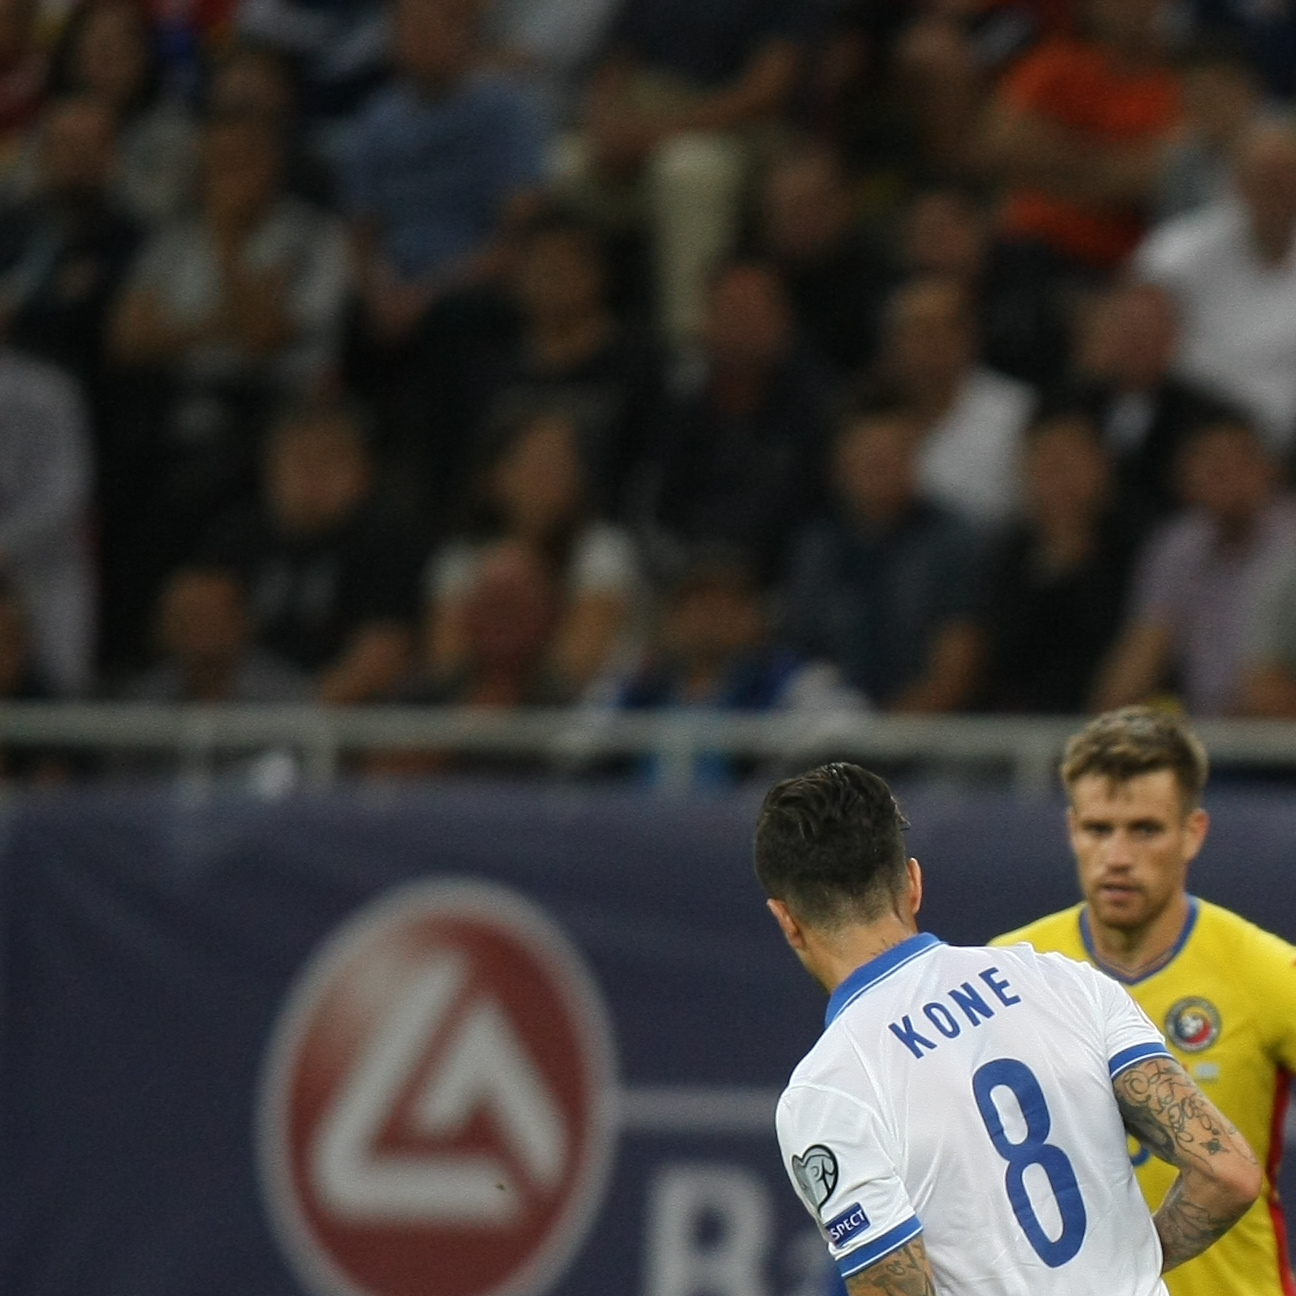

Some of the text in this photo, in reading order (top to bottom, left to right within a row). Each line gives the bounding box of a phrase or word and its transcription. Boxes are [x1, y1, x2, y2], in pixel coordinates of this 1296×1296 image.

[889, 967, 1021, 1059] KONE
[973, 1058, 1087, 1268] 8
[829, 1209, 866, 1241] SPECT
